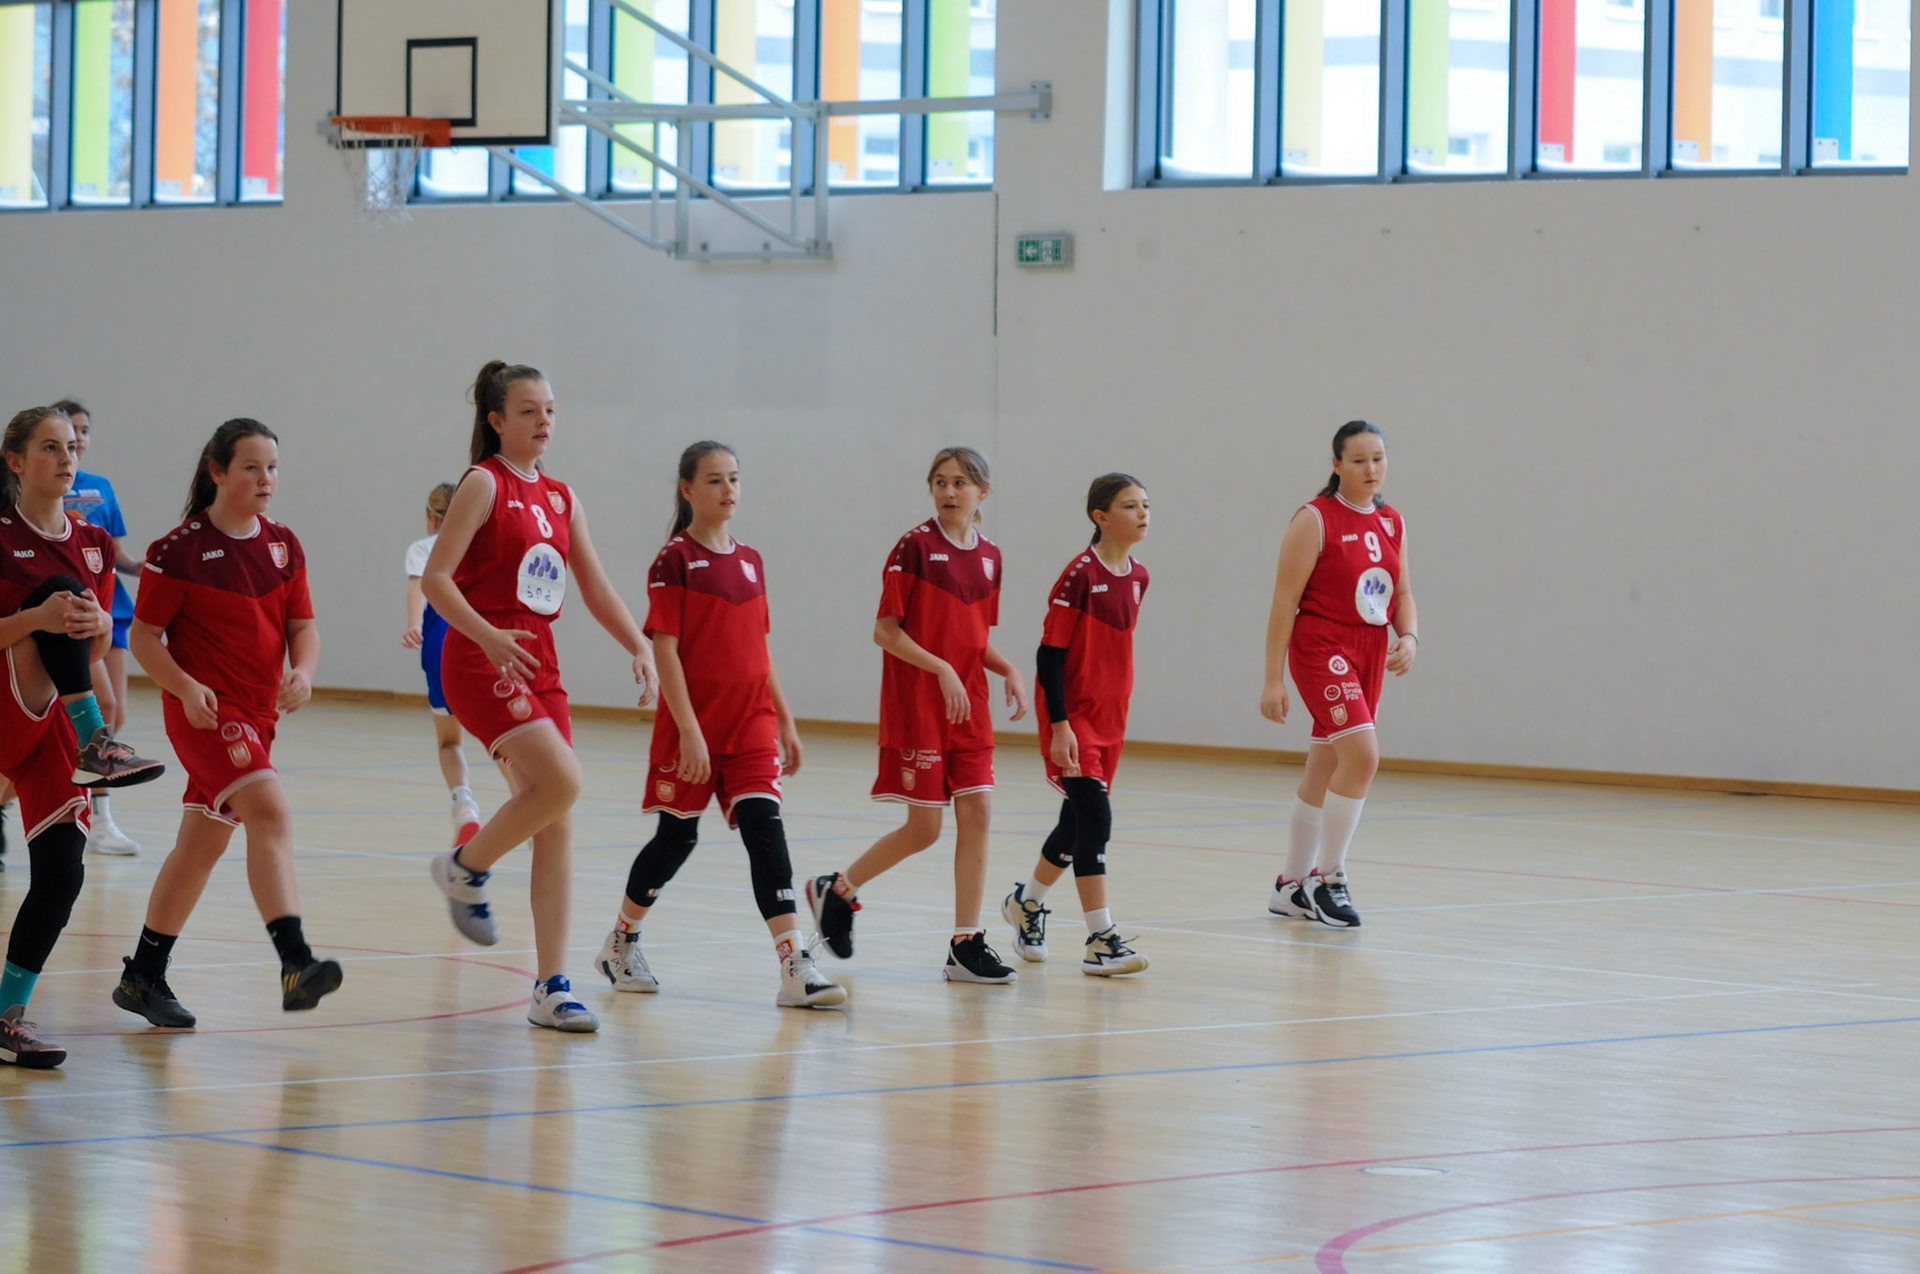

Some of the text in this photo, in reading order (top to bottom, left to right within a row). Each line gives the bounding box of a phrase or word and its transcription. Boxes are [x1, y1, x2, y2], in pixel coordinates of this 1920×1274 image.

[531, 504, 553, 538] 8
[1364, 530, 1382, 563] 9
[13, 549, 35, 558] JAKO
[202, 549, 224, 561] JAKO
[929, 553, 949, 562] JAKO
